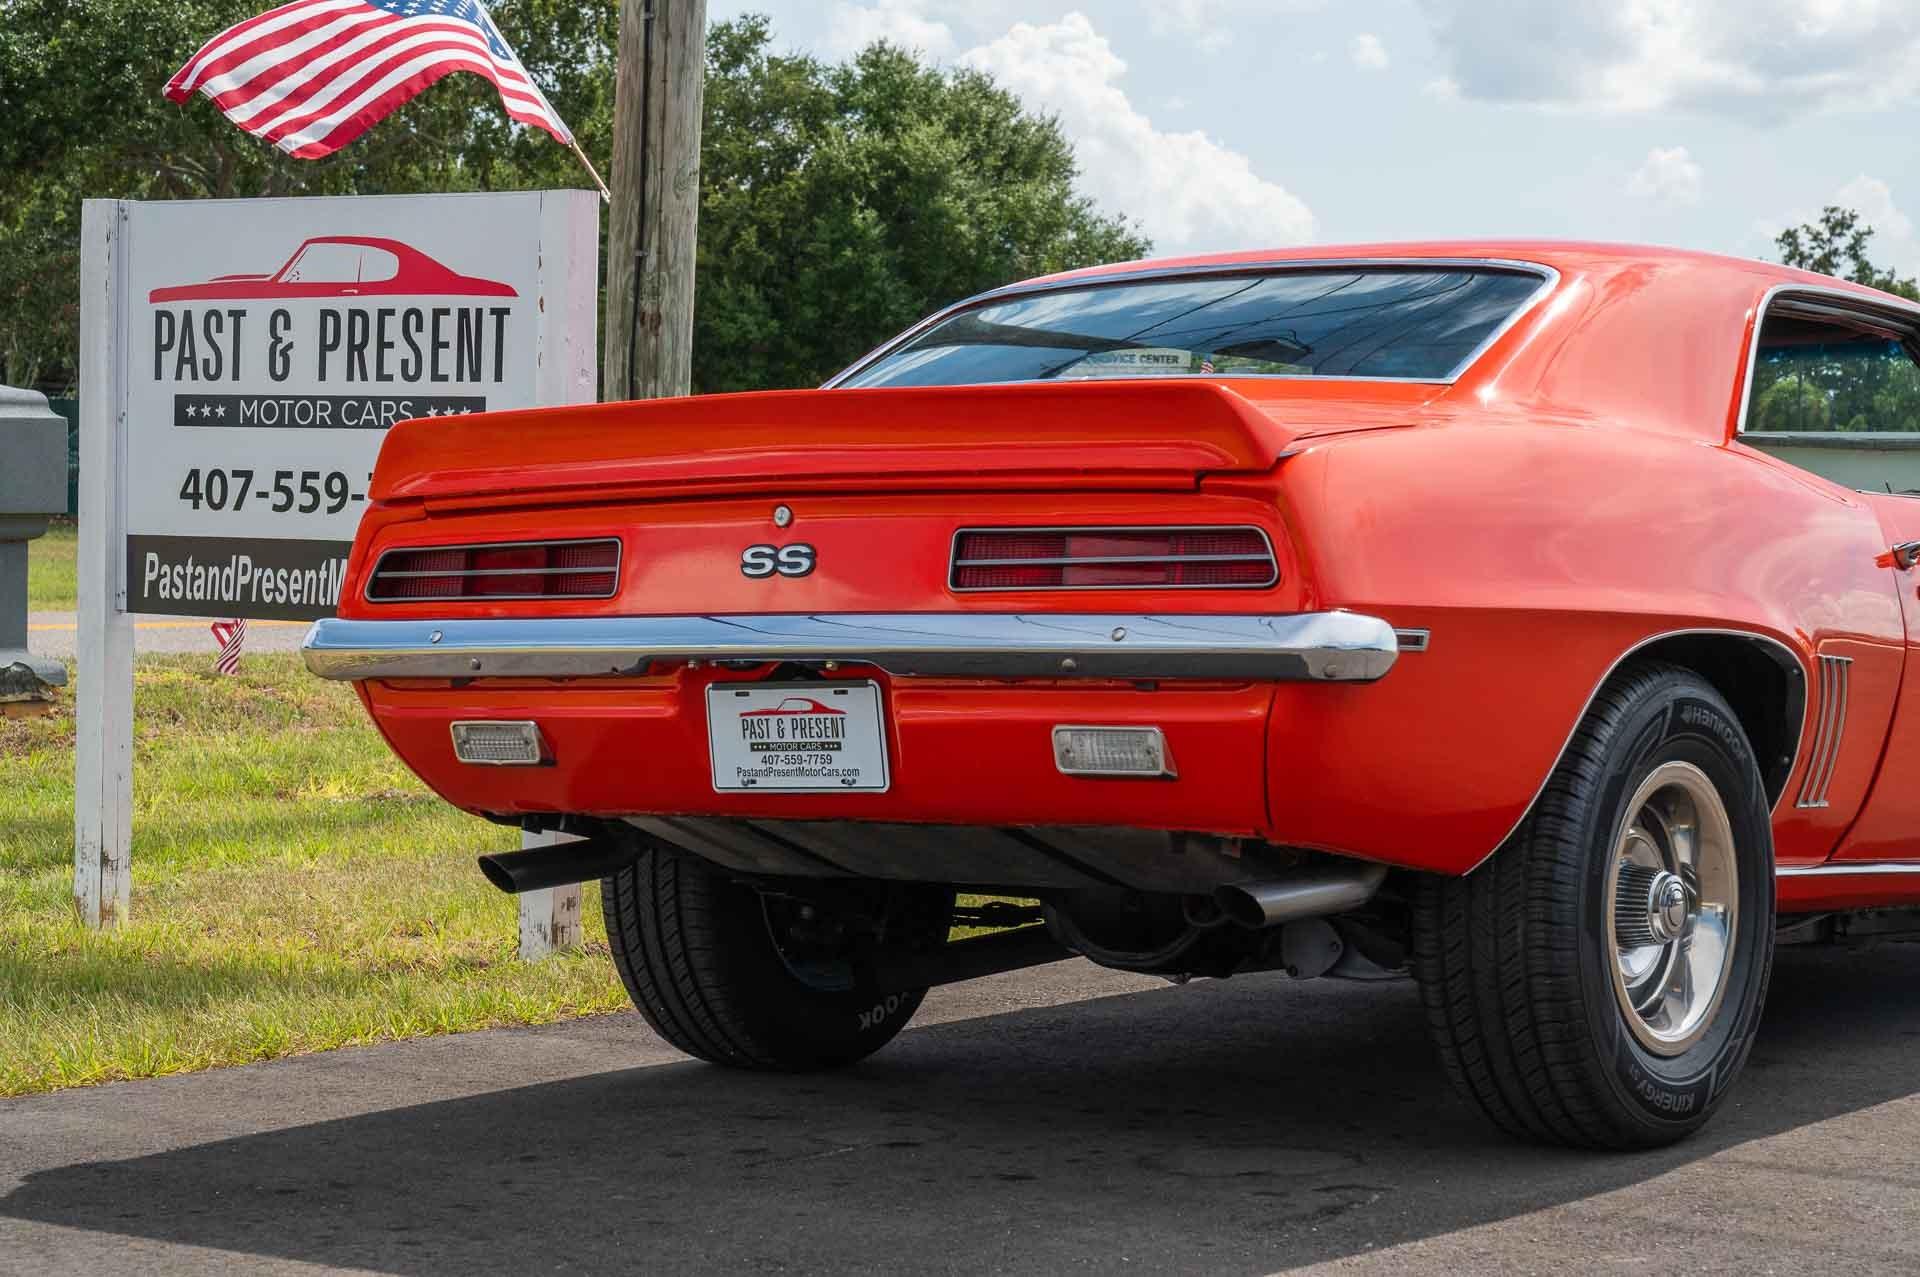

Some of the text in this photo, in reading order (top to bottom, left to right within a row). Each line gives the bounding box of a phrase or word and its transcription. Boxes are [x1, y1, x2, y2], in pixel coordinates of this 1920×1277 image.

[154, 306, 511, 383] PAST & PRESENT
[1139, 354, 1179, 364] CENTER
[240, 399, 414, 426] MOTOR CARS
[179, 468, 372, 514] 407-559-
[741, 543, 816, 578] SS
[144, 550, 348, 606] PastandPresentM
[742, 717, 846, 739] PAST & PRESENT
[770, 742, 822, 751] MOTOR CARS
[736, 766, 860, 777] PastandPresentMotorCars.com
[761, 754, 832, 765] 407-559-7759
